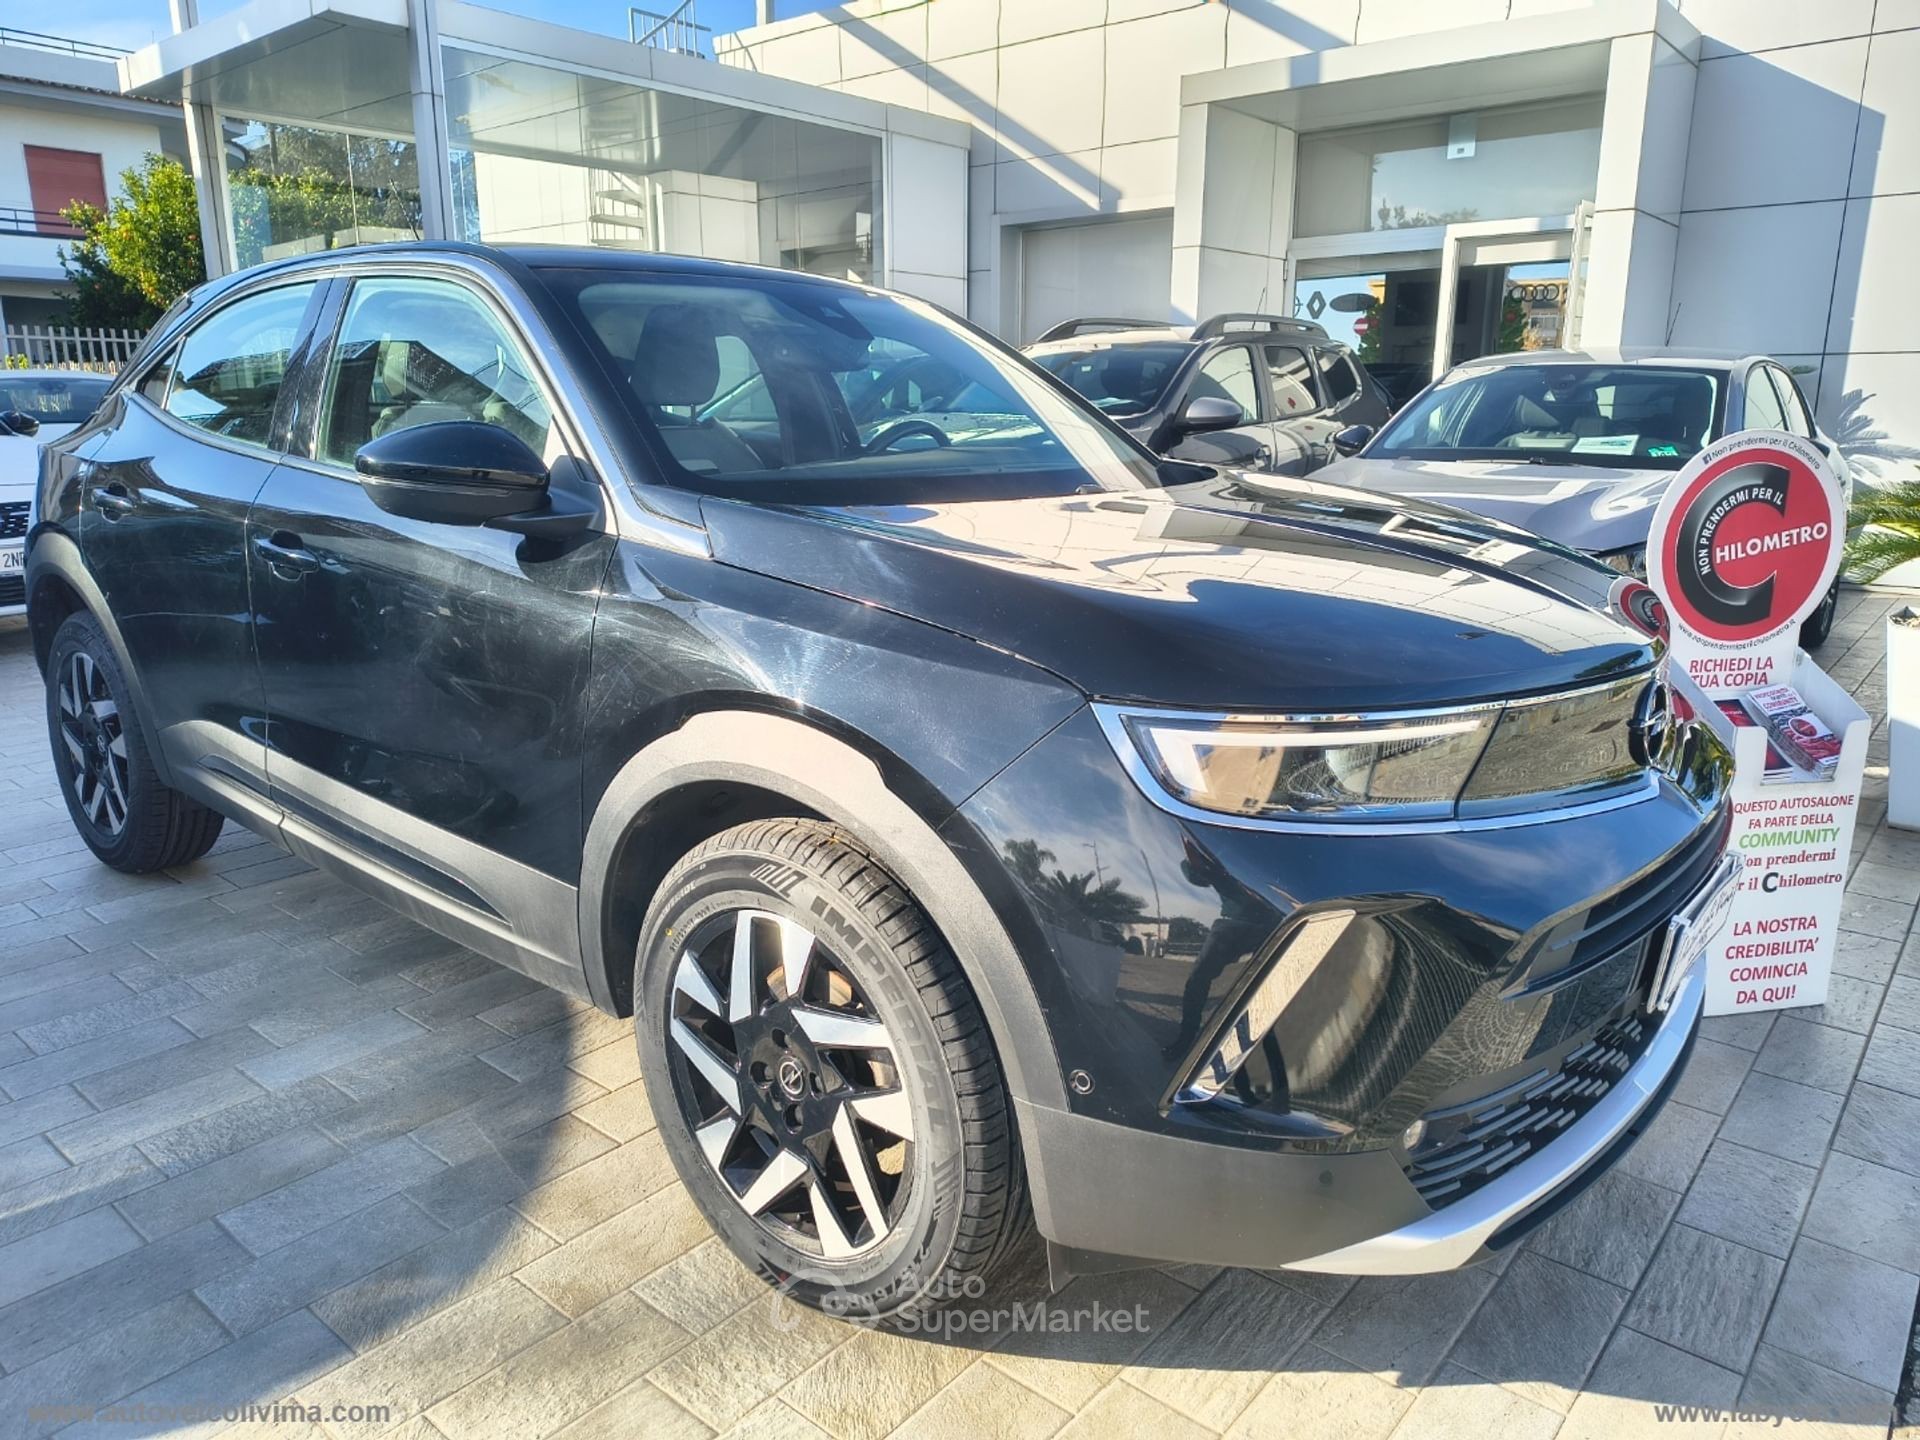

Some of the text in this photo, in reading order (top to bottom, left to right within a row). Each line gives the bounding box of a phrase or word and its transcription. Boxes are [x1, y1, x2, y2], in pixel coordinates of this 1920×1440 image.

[1698, 487, 1784, 576] NON PRENDERMI PER IL
[1715, 521, 1828, 564] HILOMETRO
[1689, 656, 1773, 673] RICHIEDI LA
[1691, 671, 1768, 688] TUA COPIA
[1734, 795, 1854, 814] QUESTO AUTOSALONE
[1748, 813, 1834, 829] FA PARTE DELLA
[1739, 827, 1840, 849] COMMUNITY
[1743, 848, 1836, 869] on prendermi
[1748, 877, 1759, 890] il
[1761, 872, 1842, 893] Chilometro
[1733, 916, 1818, 937] LA NOSTRA
[1729, 962, 1808, 983] COMINCIA
[1735, 985, 1797, 1005] DA QUI!
